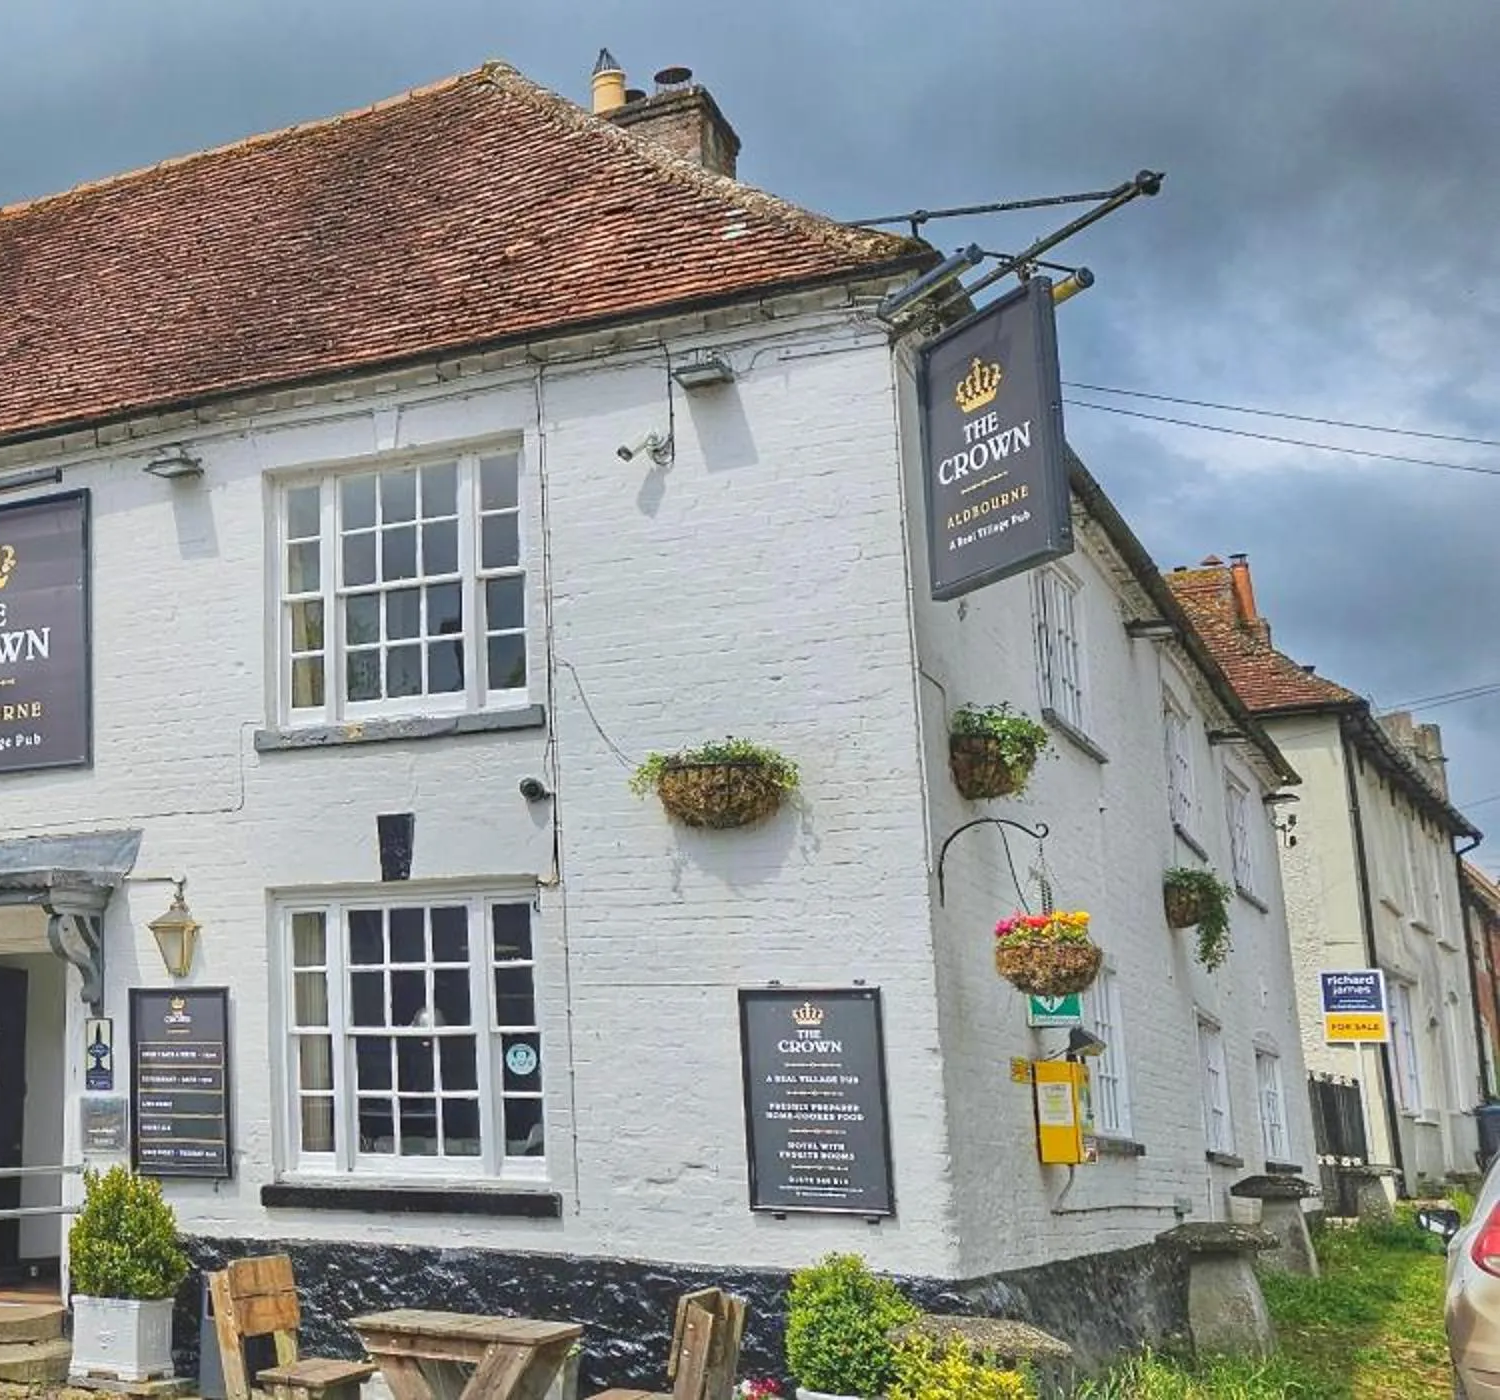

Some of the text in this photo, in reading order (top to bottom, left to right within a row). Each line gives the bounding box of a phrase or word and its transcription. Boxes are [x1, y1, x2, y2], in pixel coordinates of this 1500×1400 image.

[963, 411, 999, 444] THE
[938, 421, 1032, 486] CROWN
[947, 485, 1029, 529] ALDBOURNE
[949, 538, 957, 550] A
[977, 520, 1010, 538] Village
[1011, 510, 1032, 528] Pub
[15, 732, 42, 747] Pub
[1327, 975, 1375, 985] richard
[1333, 985, 1372, 996] james
[1331, 1023, 1380, 1031] FOR SALE
[796, 1029, 822, 1040] THE
[778, 1040, 842, 1053] CROWN
